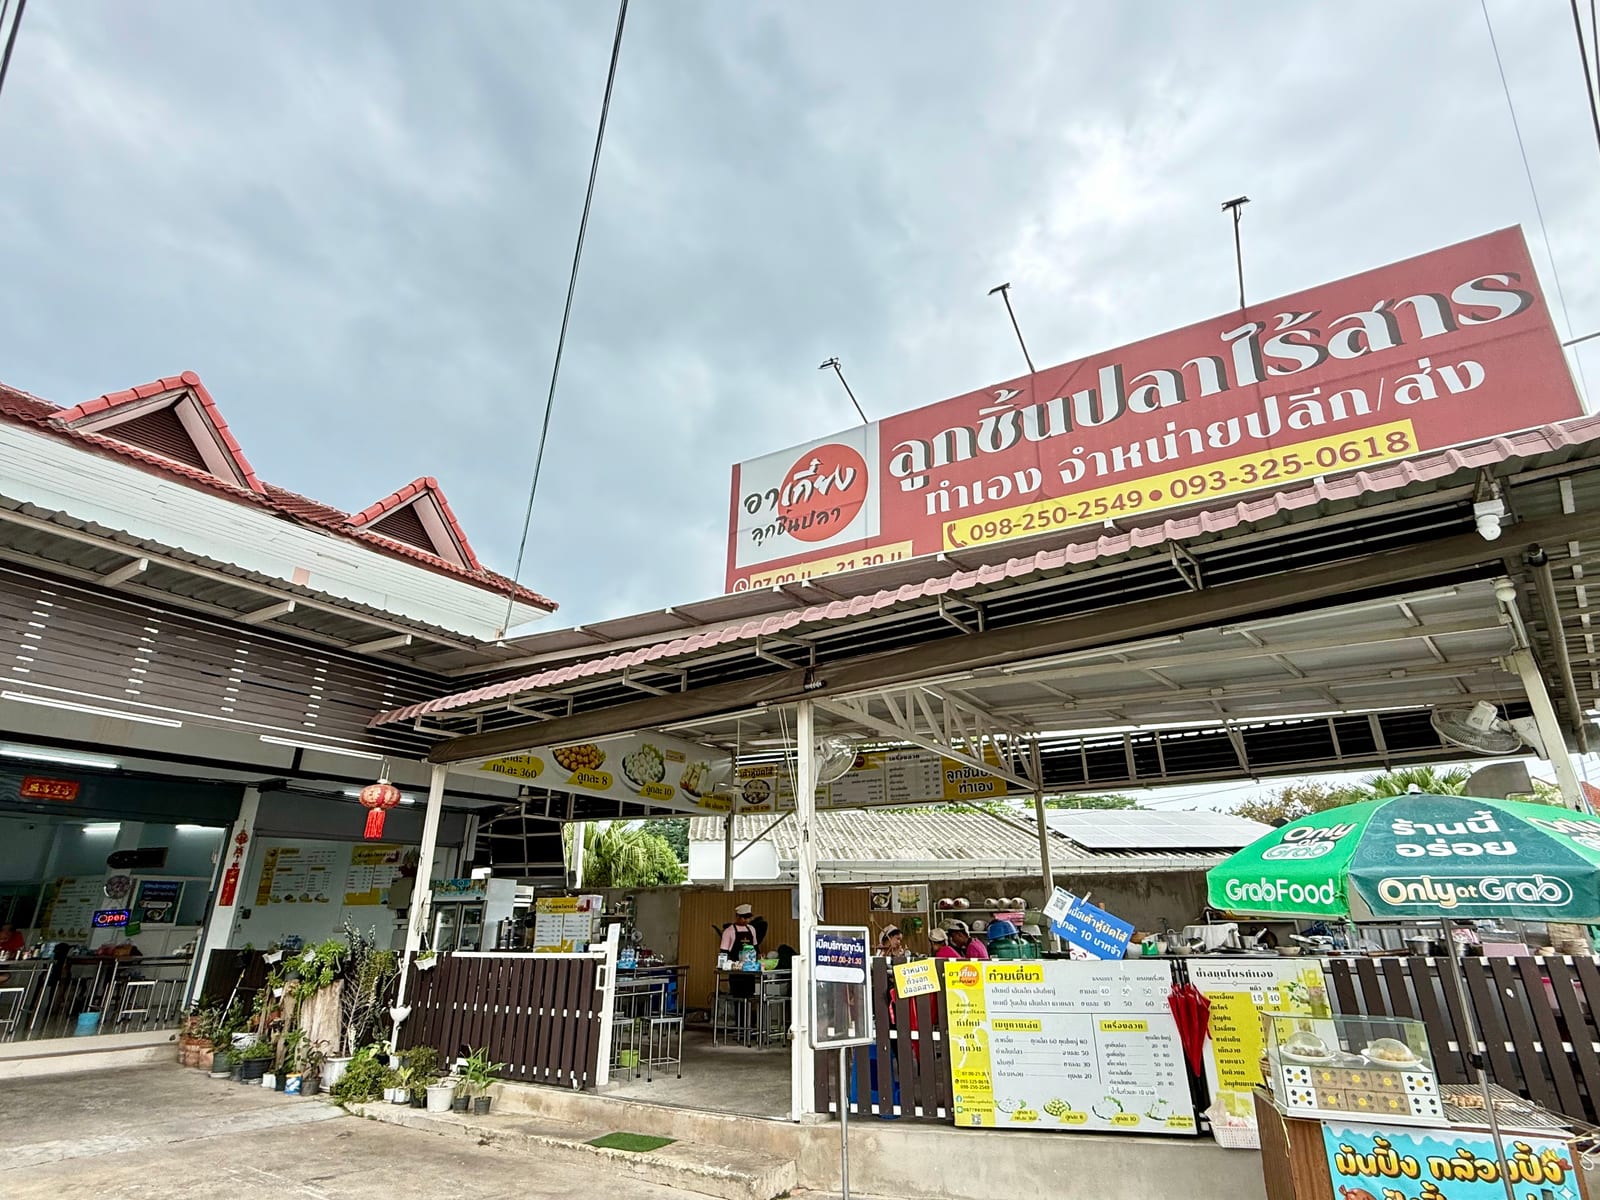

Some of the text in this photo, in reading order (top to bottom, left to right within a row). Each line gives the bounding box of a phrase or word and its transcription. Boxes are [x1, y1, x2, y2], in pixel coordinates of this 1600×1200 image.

[889, 273, 1534, 492] ลูกชิ้นปลาไร้สาร
[926, 357, 1486, 515] ทำเอง จำหน่ายปลีก/ส่ง
[970, 431, 1410, 541] 098-250-2549 093-325-0618
[751, 507, 841, 546] ลูกชิ้นปลา
[837, 554, 883, 571] 2130
[520, 769, 537, 778] 360
[577, 772, 608, 785] ลูกละ 8
[646, 787, 662, 795] ลูกละ
[959, 780, 993, 793] ทำเอง
[1283, 822, 1356, 842] Only
[1391, 810, 1500, 837] ร้านนี้
[1264, 842, 1334, 859] Grab
[1395, 840, 1518, 857] อร่อย
[1226, 877, 1336, 904] GrabFood
[1380, 874, 1563, 907] Only at Grab
[98, 913, 126, 923] Open
[816, 937, 864, 954] เปิดบริการทุกวัน
[1081, 930, 1092, 941] 10
[1093, 938, 1121, 957] บาทจ้า
[902, 965, 929, 976] จำหน่าย
[989, 966, 1040, 981] ก๋วยเตี๋ยว
[1196, 967, 1274, 980] น้ำสมุนไพรทำเอง
[903, 983, 935, 994] ปลอดสาร
[906, 976, 929, 986] ถั่วงอก
[994, 1021, 1039, 1030] เมนูทานเล่น
[959, 1044, 982, 1054] ทุกวัน
[1335, 1136, 1420, 1179] มันปิ้ง
